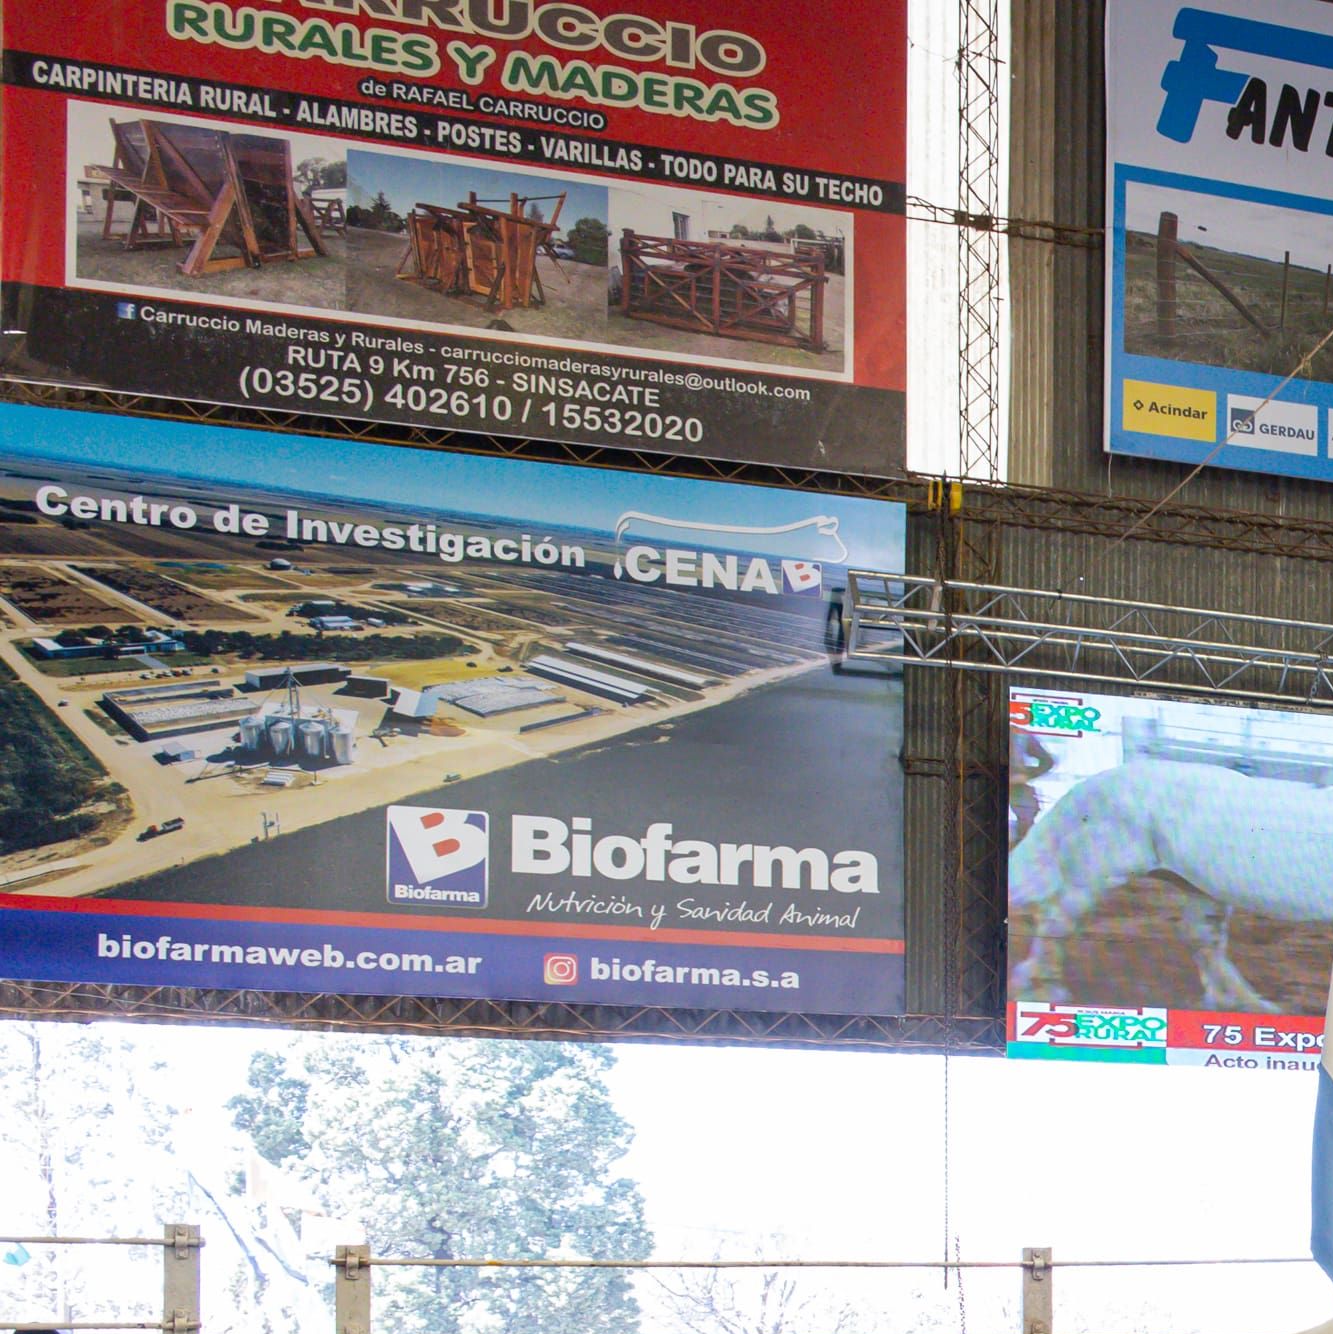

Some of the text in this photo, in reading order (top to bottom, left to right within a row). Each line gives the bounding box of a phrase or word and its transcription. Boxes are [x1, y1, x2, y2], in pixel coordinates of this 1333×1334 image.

[170, 2, 776, 126] RURALES Y MADERAS
[361, 80, 605, 130] de RAFAEL CARRUCCIO
[32, 60, 883, 207] CARPINTERIA RURAL ALAMBRES POSTES VARILLAS TODO PARA SU TECHO
[140, 306, 811, 401] Carruccio Maderas y Rurales carrucciomaderasyrurales@outlook.com
[287, 345, 661, 408] RUTA 9 Km 756 SINSACATE
[240, 366, 374, 411] (03525)
[385, 383, 512, 421] 402610
[542, 402, 704, 443] 15532020
[1148, 401, 1208, 420] Acindar
[1259, 422, 1315, 441] GERDAU
[36, 485, 586, 568] Centro de Investigación
[511, 814, 880, 893] Biofarma
[395, 884, 480, 902] Biofarma
[526, 891, 861, 930] Nutrición y Sanidad Animal
[98, 933, 800, 989] biofarmaweb.com.ar biofarma.s.a
[1020, 1011, 1167, 1038] 75 EXPO
[1075, 1026, 1167, 1042] RURAL
[1203, 1024, 1243, 1045] 75
[1204, 1054, 1320, 1072] Acto inau
